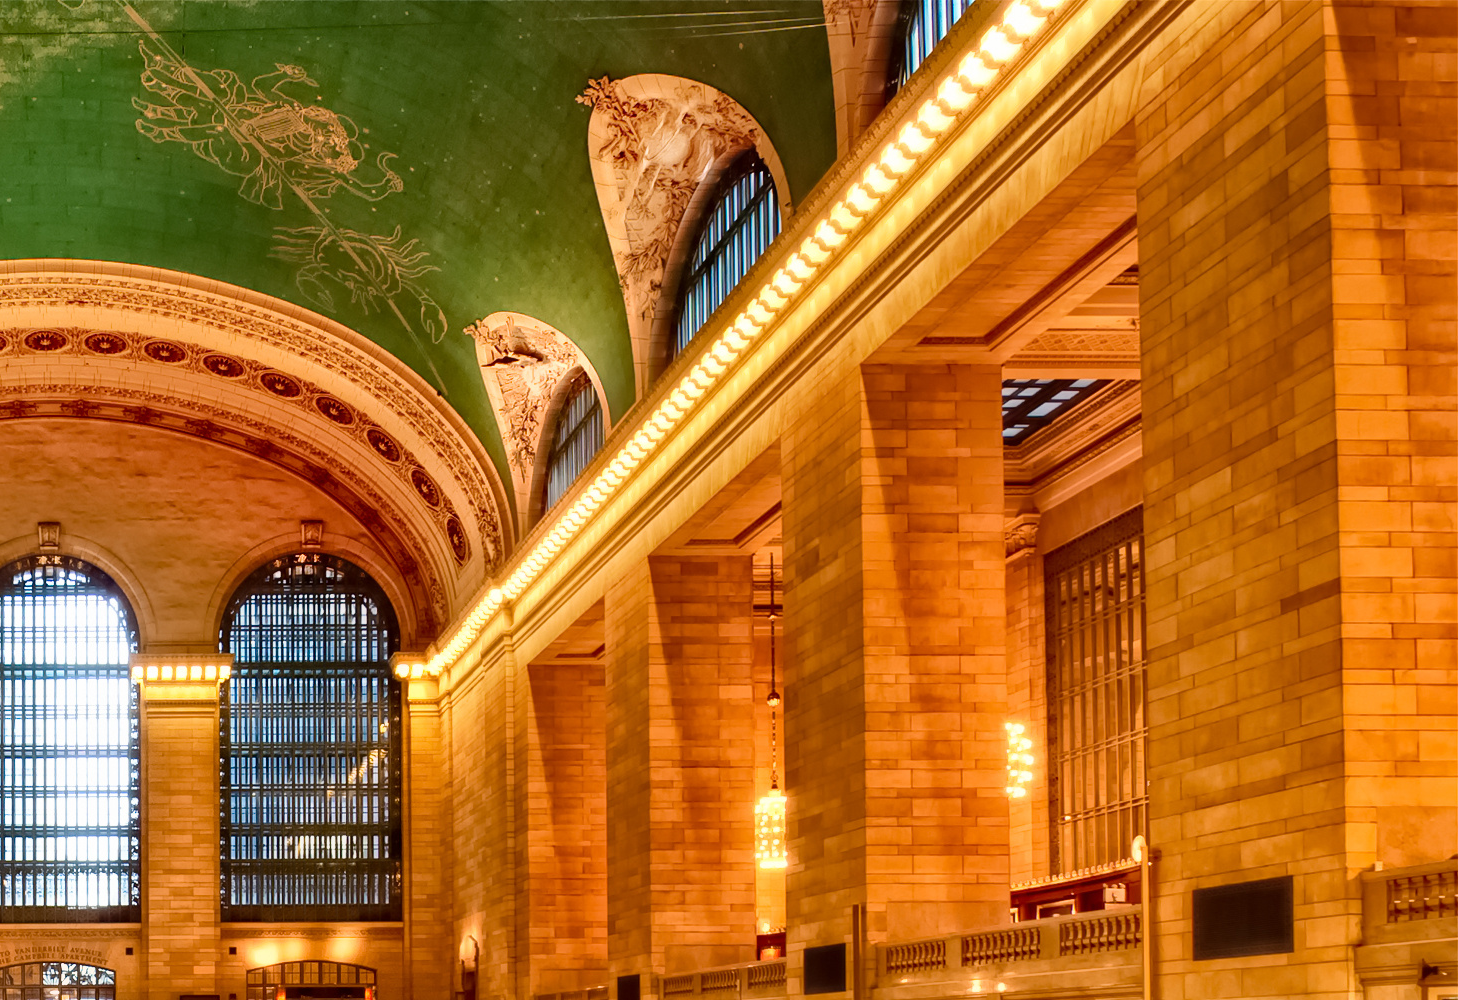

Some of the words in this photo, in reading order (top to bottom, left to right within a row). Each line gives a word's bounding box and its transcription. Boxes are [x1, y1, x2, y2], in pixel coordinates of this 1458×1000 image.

[0, 950, 11, 958] TO
[15, 946, 65, 954] VANDERBILT
[70, 947, 102, 957] AVENUE
[14, 953, 55, 962] CAMPBELL
[60, 953, 109, 966] APARTMENT
